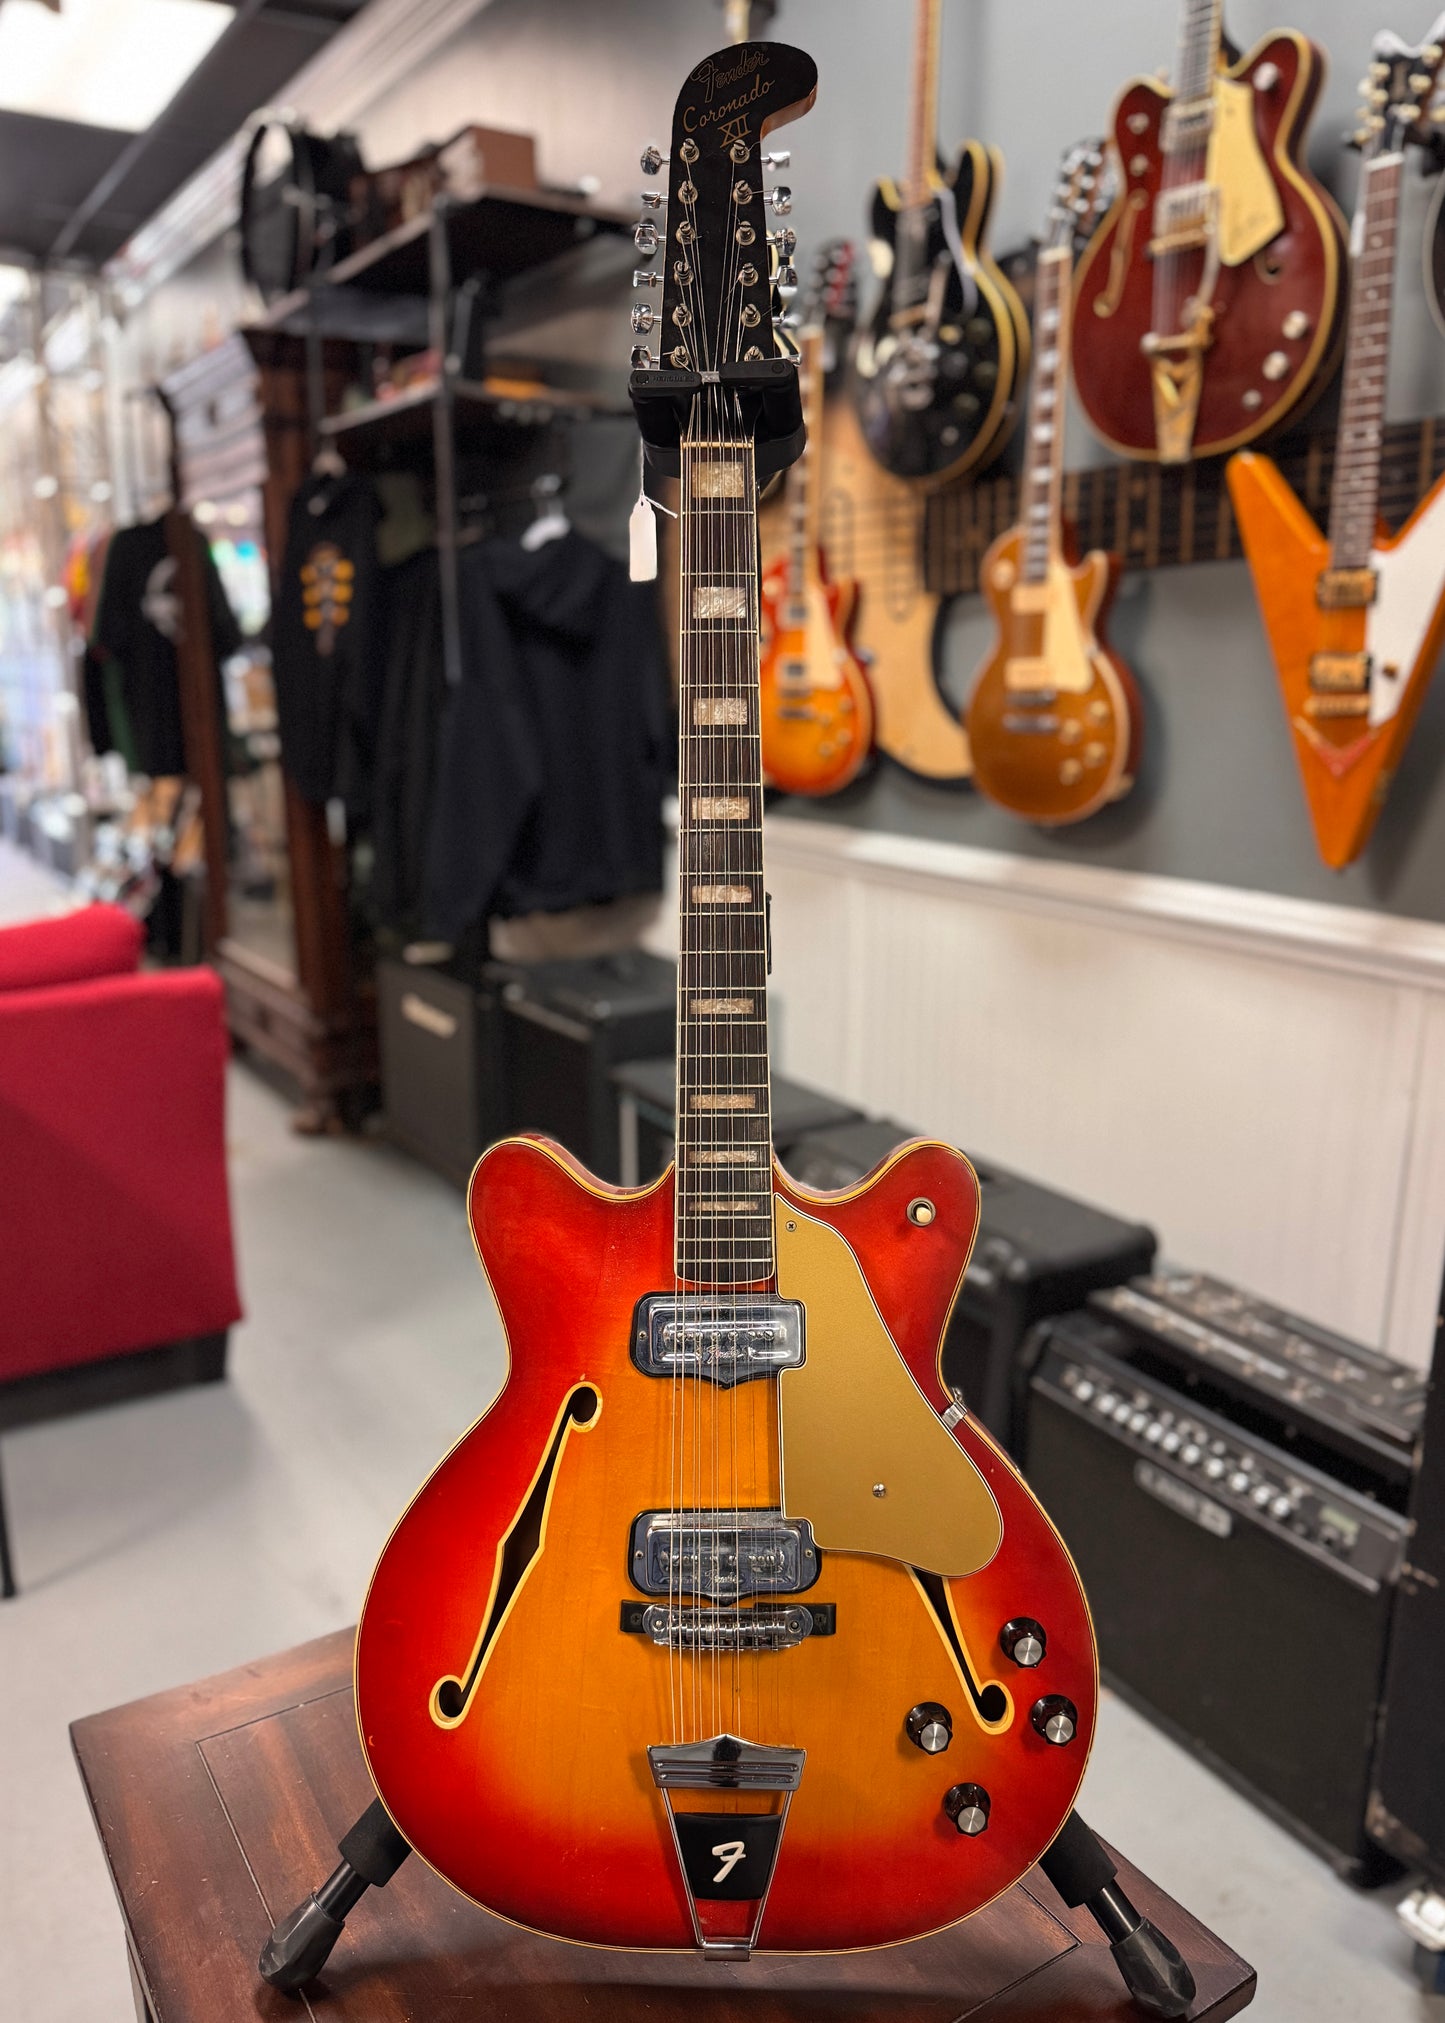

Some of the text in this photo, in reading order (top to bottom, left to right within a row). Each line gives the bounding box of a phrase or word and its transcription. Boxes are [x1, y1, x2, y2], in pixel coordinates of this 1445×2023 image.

[682, 73, 776, 133] Coronado
[691, 50, 770, 103] Fender
[717, 112, 752, 149] XII
